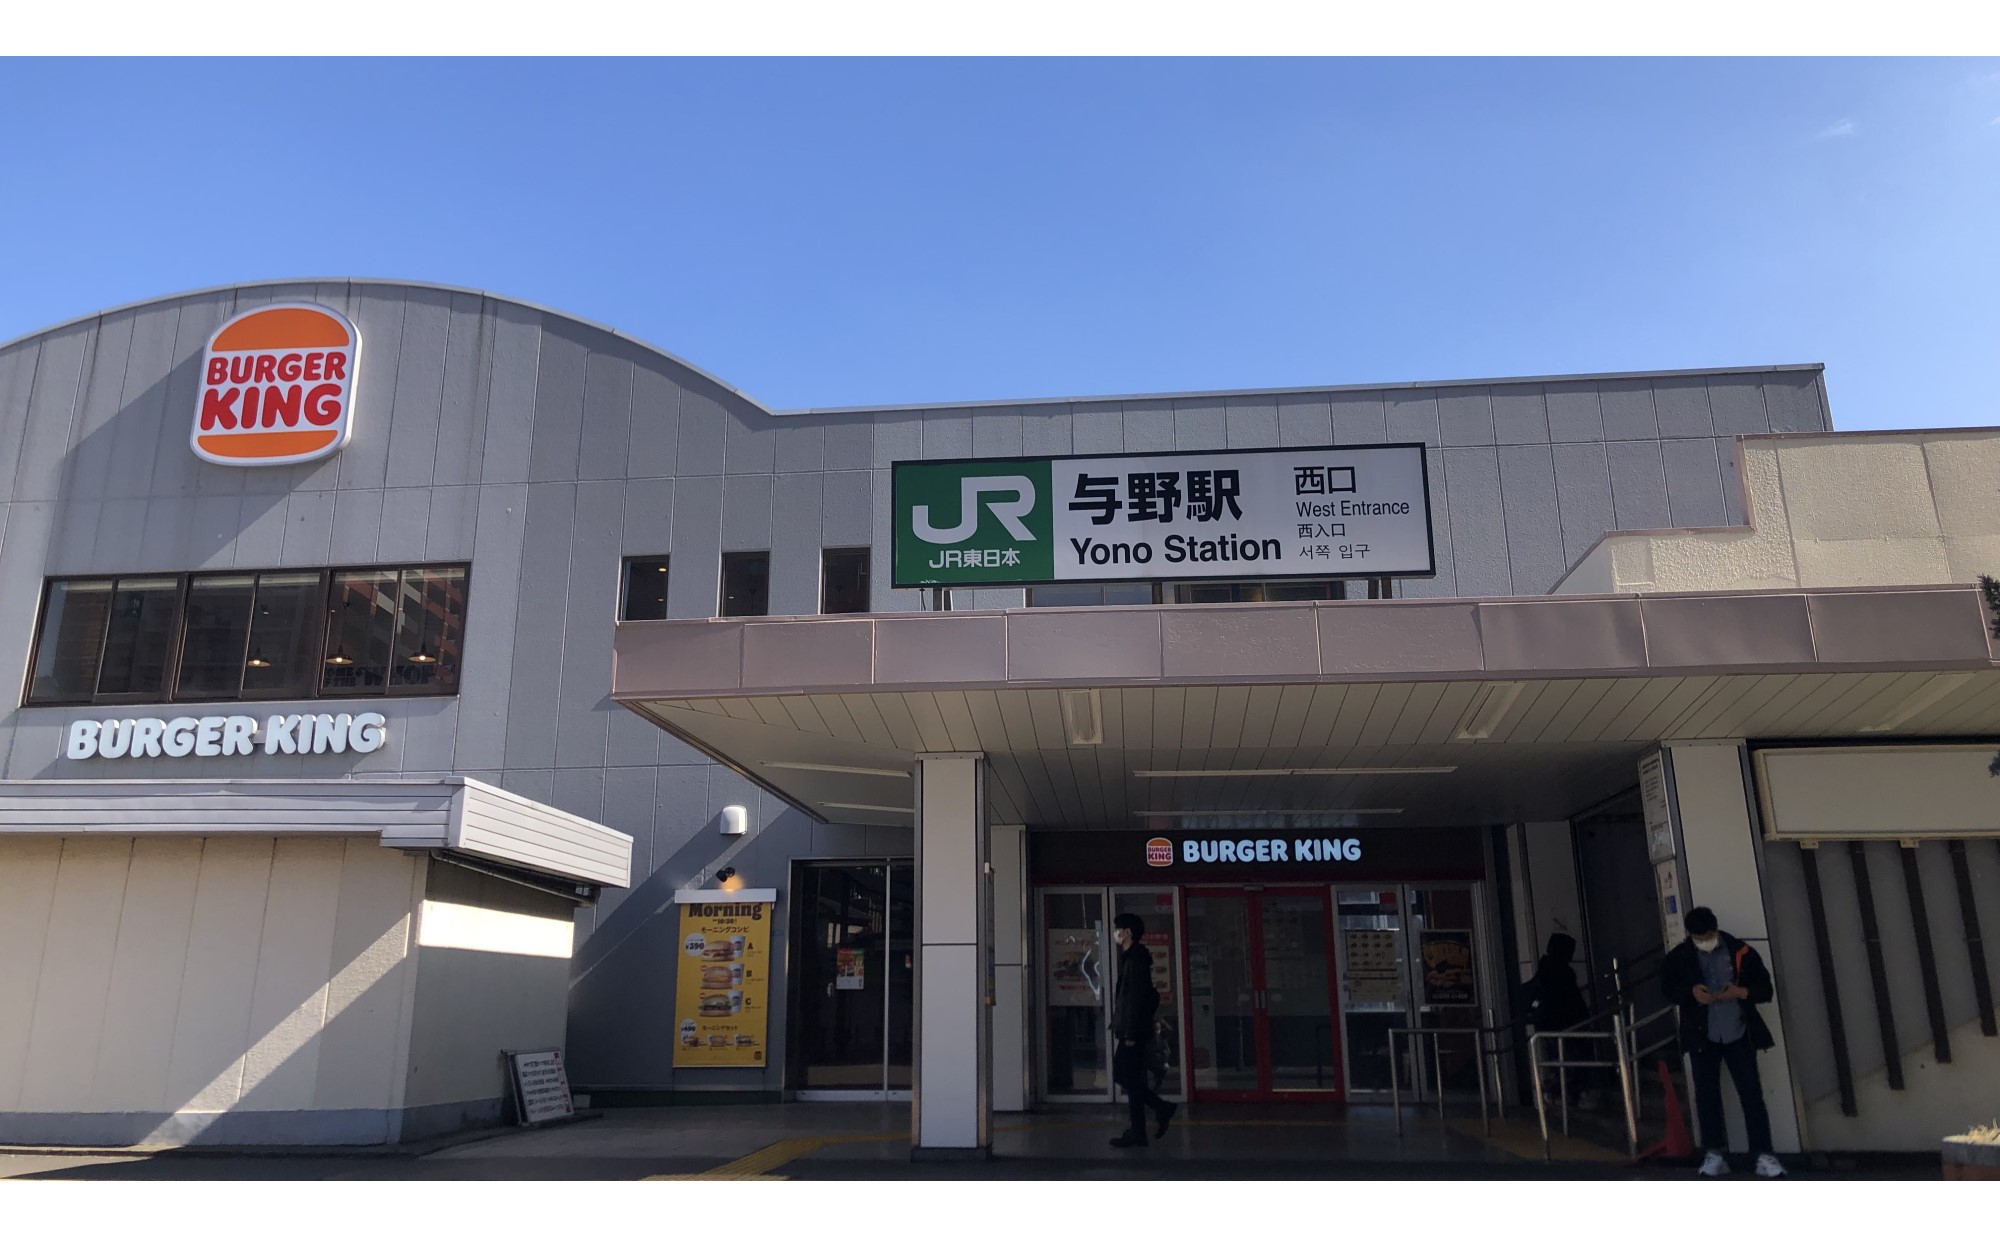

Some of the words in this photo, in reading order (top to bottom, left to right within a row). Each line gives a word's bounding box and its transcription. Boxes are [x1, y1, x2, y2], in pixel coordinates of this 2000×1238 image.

[206, 351, 346, 386] BURGER
[199, 384, 343, 431] KING
[1294, 465, 1357, 495] 西口
[912, 475, 1037, 544] JR
[1068, 469, 1242, 525] 与野駅
[1295, 501, 1335, 517] West
[1341, 499, 1410, 517] Entrance
[1297, 522, 1346, 539] 西入口
[928, 548, 1020, 569] JR東日本
[1070, 536, 1153, 566] Yono
[1164, 532, 1281, 562] Station
[1299, 544, 1331, 560] 서쪽
[1339, 543, 1371, 559] 입구
[66, 715, 257, 760] BURGER
[264, 712, 386, 756] KING
[1183, 839, 1288, 863] BURGER
[1295, 838, 1362, 862] KING
[688, 903, 763, 920] Morning
[747, 942, 754, 950] A
[745, 997, 752, 1005] C
